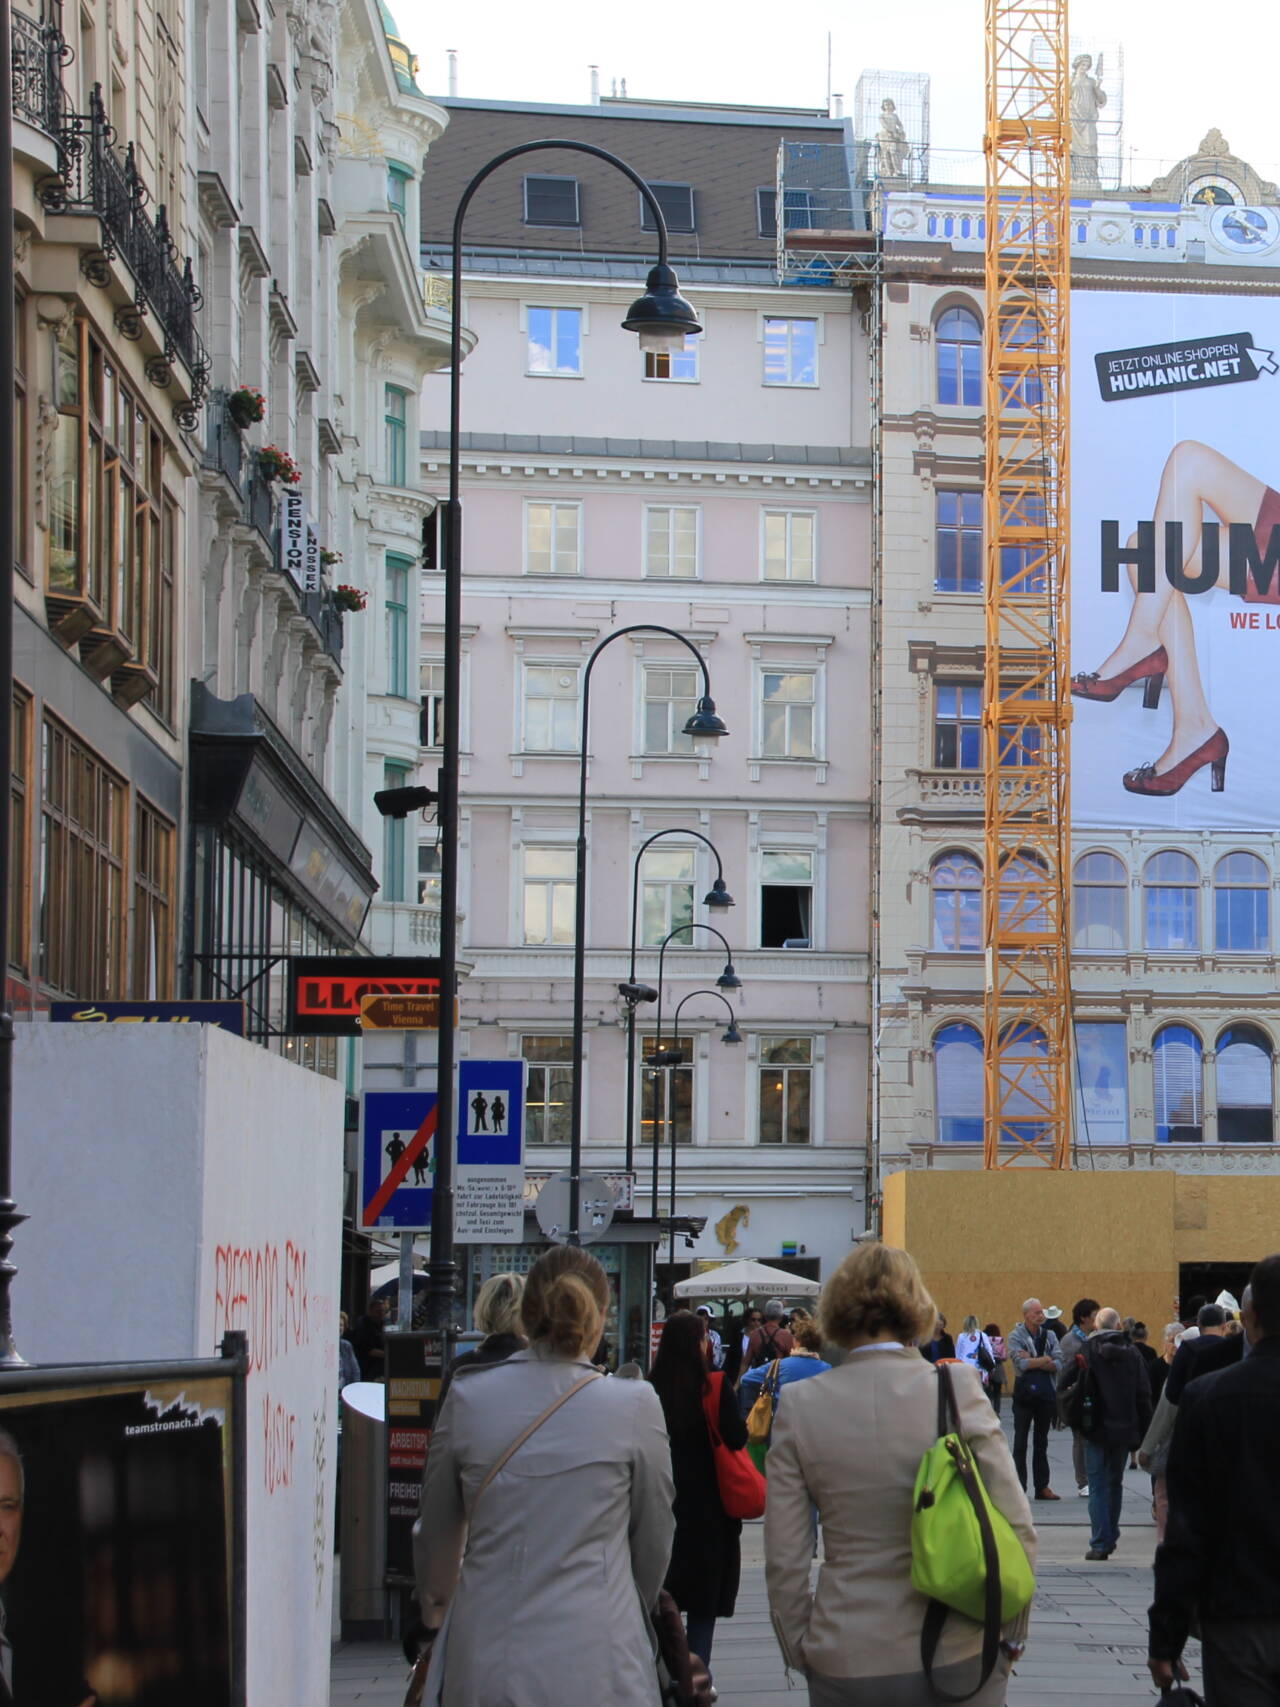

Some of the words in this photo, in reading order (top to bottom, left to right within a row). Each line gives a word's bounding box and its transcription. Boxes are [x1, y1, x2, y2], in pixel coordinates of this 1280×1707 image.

[1108, 357, 1140, 373] JETZT
[1141, 350, 1184, 367] ONLINE
[1185, 343, 1239, 361] SHOPPEN
[1109, 358, 1241, 393] HUMANIC.NET
[287, 498, 303, 569] PENSION
[306, 538, 318, 591] NOSSEK
[1230, 612, 1260, 631] WE
[383, 1002, 404, 1012] Time
[407, 1002, 435, 1012] Travel
[392, 1015, 424, 1025] Vienna
[125, 1417, 204, 1436] teamstronach.at
[390, 1432, 428, 1449] ARBEITSPL
